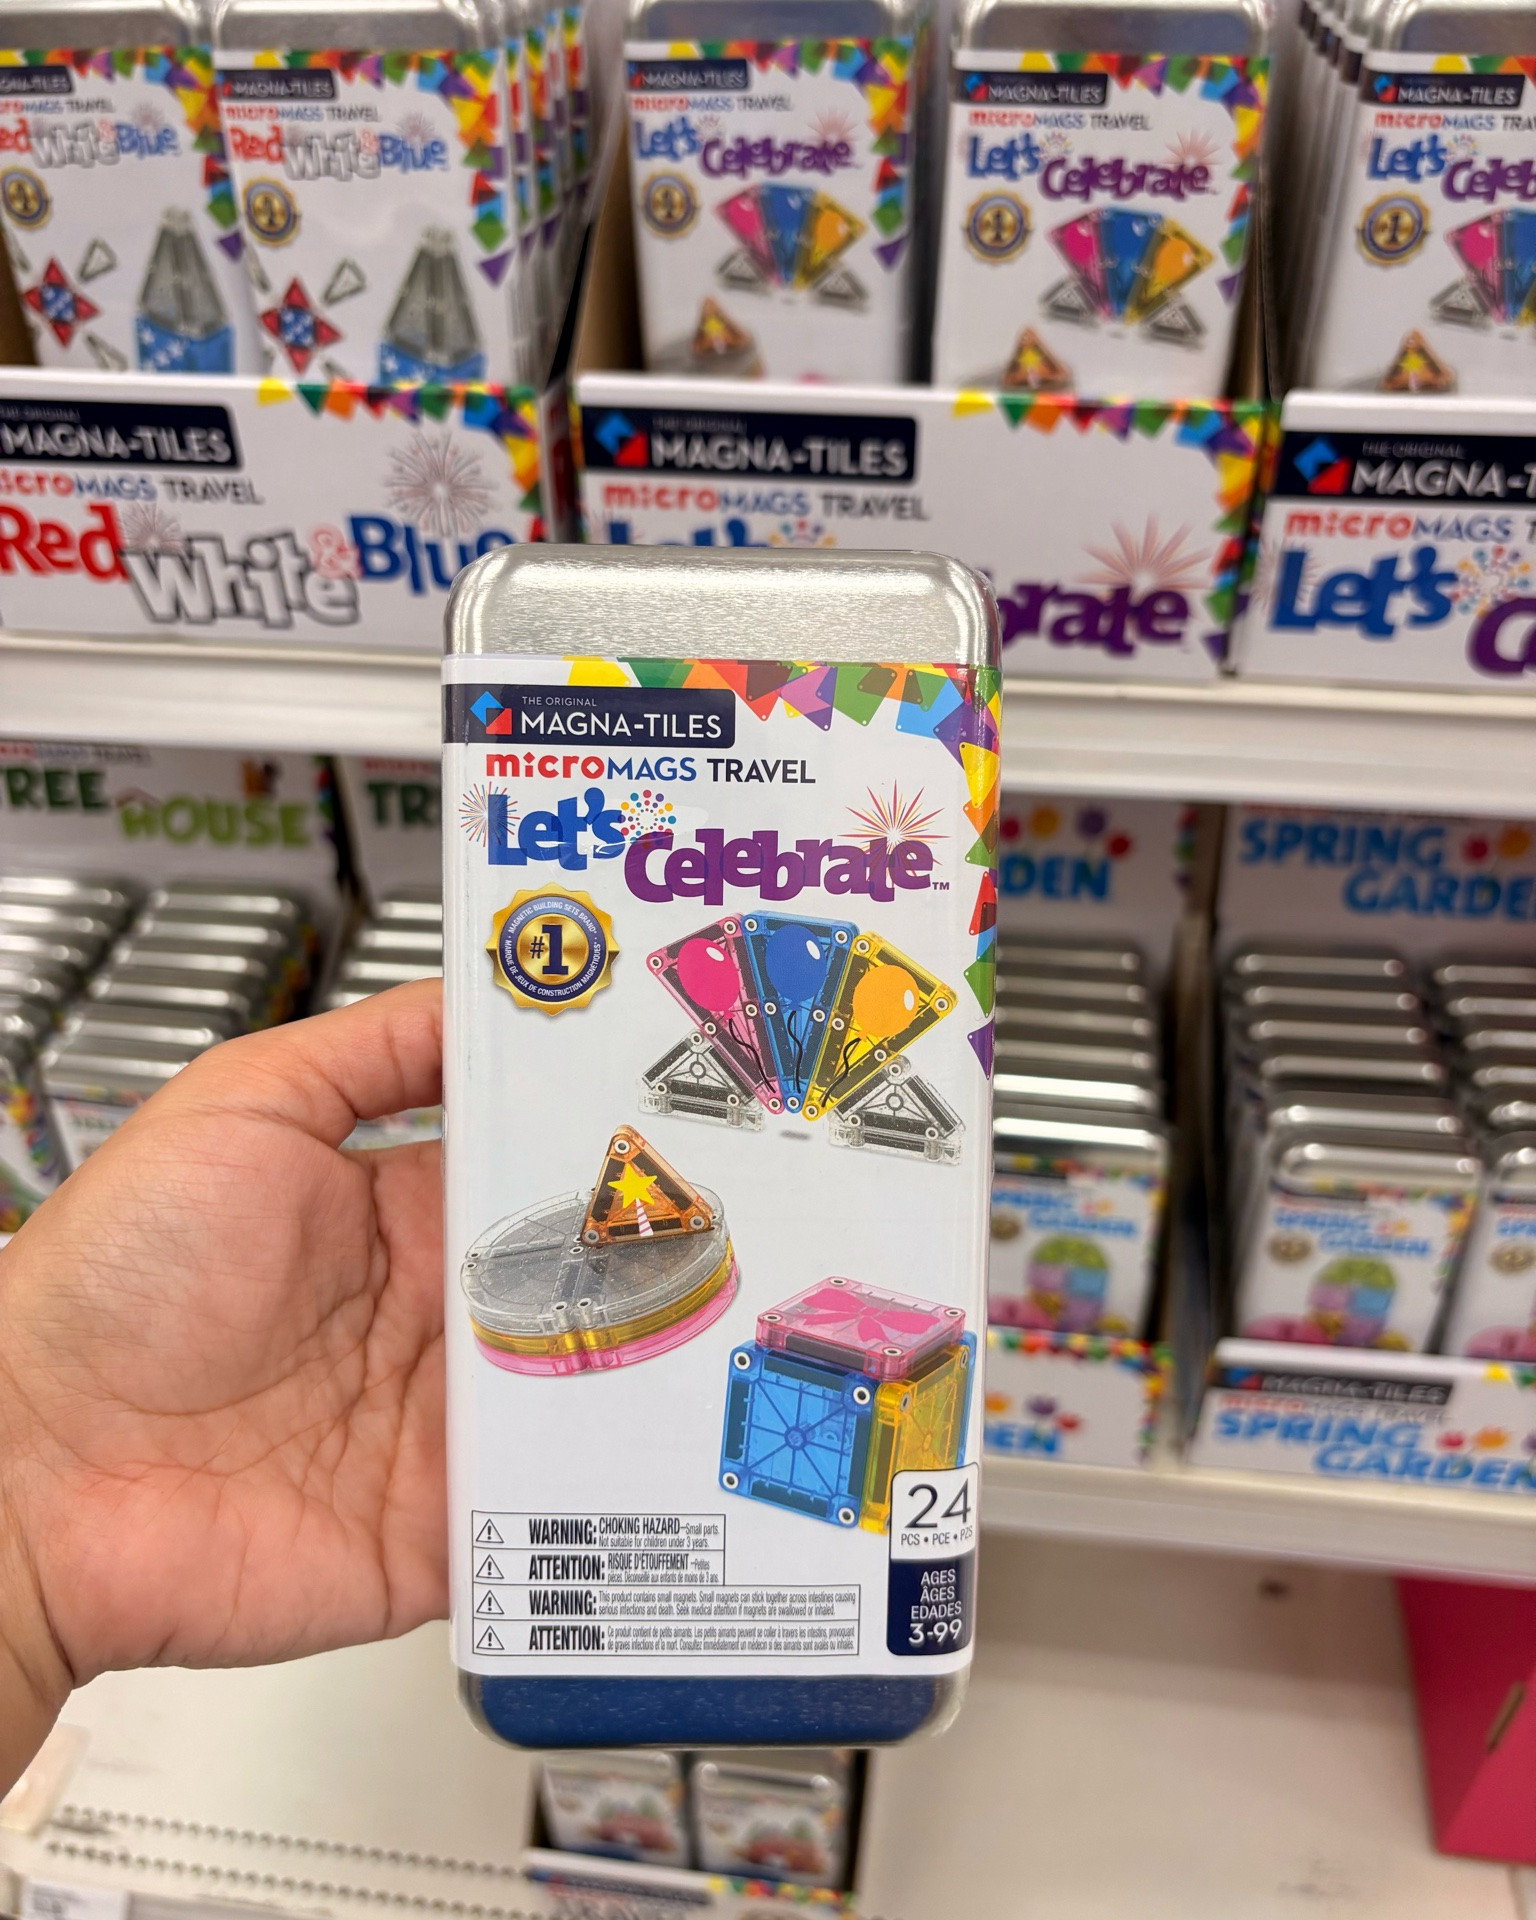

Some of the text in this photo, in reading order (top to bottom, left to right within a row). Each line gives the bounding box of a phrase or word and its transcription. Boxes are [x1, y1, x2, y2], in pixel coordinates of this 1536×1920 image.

[1398, 86, 1515, 105] MAGNA-TILES
[115, 124, 177, 159] Blue
[229, 126, 284, 162] Red
[379, 134, 447, 173] Blue
[635, 117, 700, 161] Let's
[702, 136, 853, 178] Celebrate
[967, 132, 1041, 181] Let's
[1368, 135, 1447, 183] Let's
[0, 422, 231, 463] MAGNA-TILES
[651, 432, 908, 476] MAGNA-TILES
[163, 476, 266, 505] TRAVEL
[603, 484, 931, 521] microMAGS TRAVEL
[1284, 511, 1514, 543] microMAGS
[0, 501, 130, 583] Red
[121, 531, 361, 628] White
[1269, 544, 1459, 641] Let's
[522, 696, 597, 708] THE ORIGINAL
[521, 711, 722, 738] MAGNA-TILES
[485, 752, 816, 784] microMAGS TRAVEL
[488, 787, 626, 872] Let's
[1239, 817, 1447, 870] SPRING
[1341, 868, 1536, 922] GARDE
[508, 907, 533, 933] MAGNETIC
[533, 902, 563, 911] BUILDING
[564, 904, 578, 916] SETS
[530, 924, 568, 975] #1
[504, 940, 514, 965] MARQUE
[509, 965, 519, 975] DE
[515, 974, 529, 988] JEUX
[528, 983, 538, 992] DE
[538, 981, 583, 996] CONSTRUCTION
[1215, 1410, 1422, 1448] SPRING
[905, 1478, 971, 1528] 24
[529, 1519, 597, 1544] WARNING:
[599, 1517, 639, 1534] CHOKING
[901, 1525, 973, 1545] PCS PCE PZS
[599, 1536, 609, 1547] Not
[611, 1536, 633, 1547] suitable
[634, 1536, 642, 1547] for
[644, 1536, 667, 1547] children
[669, 1536, 685, 1547] under
[687, 1536, 690, 1547] 3
[528, 1554, 605, 1581] ATTENTION:
[608, 1553, 632, 1570] RISQUE
[921, 1569, 956, 1585] AGES
[529, 1590, 597, 1615] WARNING:
[599, 1591, 610, 1602] This
[612, 1591, 632, 1604] product
[633, 1591, 656, 1602] contains
[657, 1591, 672, 1602] small
[699, 1591, 714, 1602] Small
[716, 1592, 739, 1604] magnets
[741, 1591, 750, 1602] can
[752, 1591, 764, 1602] stick
[766, 1591, 788, 1604] together
[789, 1591, 807, 1602] across
[808, 1591, 833, 1602] intestines
[835, 1591, 856, 1604] causing
[920, 1586, 955, 1602] ÂGES
[599, 1604, 618, 1615] serious
[620, 1604, 645, 1615] infections
[647, 1604, 657, 1615] and
[676, 1604, 689, 1615] Seek
[691, 1604, 712, 1615] medical
[714, 1604, 737, 1615] attention
[744, 1605, 766, 1618] magnets
[768, 1604, 777, 1615] are
[778, 1604, 806, 1615] swallowed
[808, 1604, 813, 1615] or
[911, 1601, 961, 1620] EDADES
[528, 1625, 605, 1650] ATTENTION:
[608, 1626, 614, 1637] Ce
[615, 1626, 631, 1638] produit
[633, 1626, 651, 1637] contient
[653, 1626, 658, 1637] de
[608, 1640, 614, 1650] de
[631, 1640, 654, 1650] infections
[909, 1618, 962, 1643] 3-99
